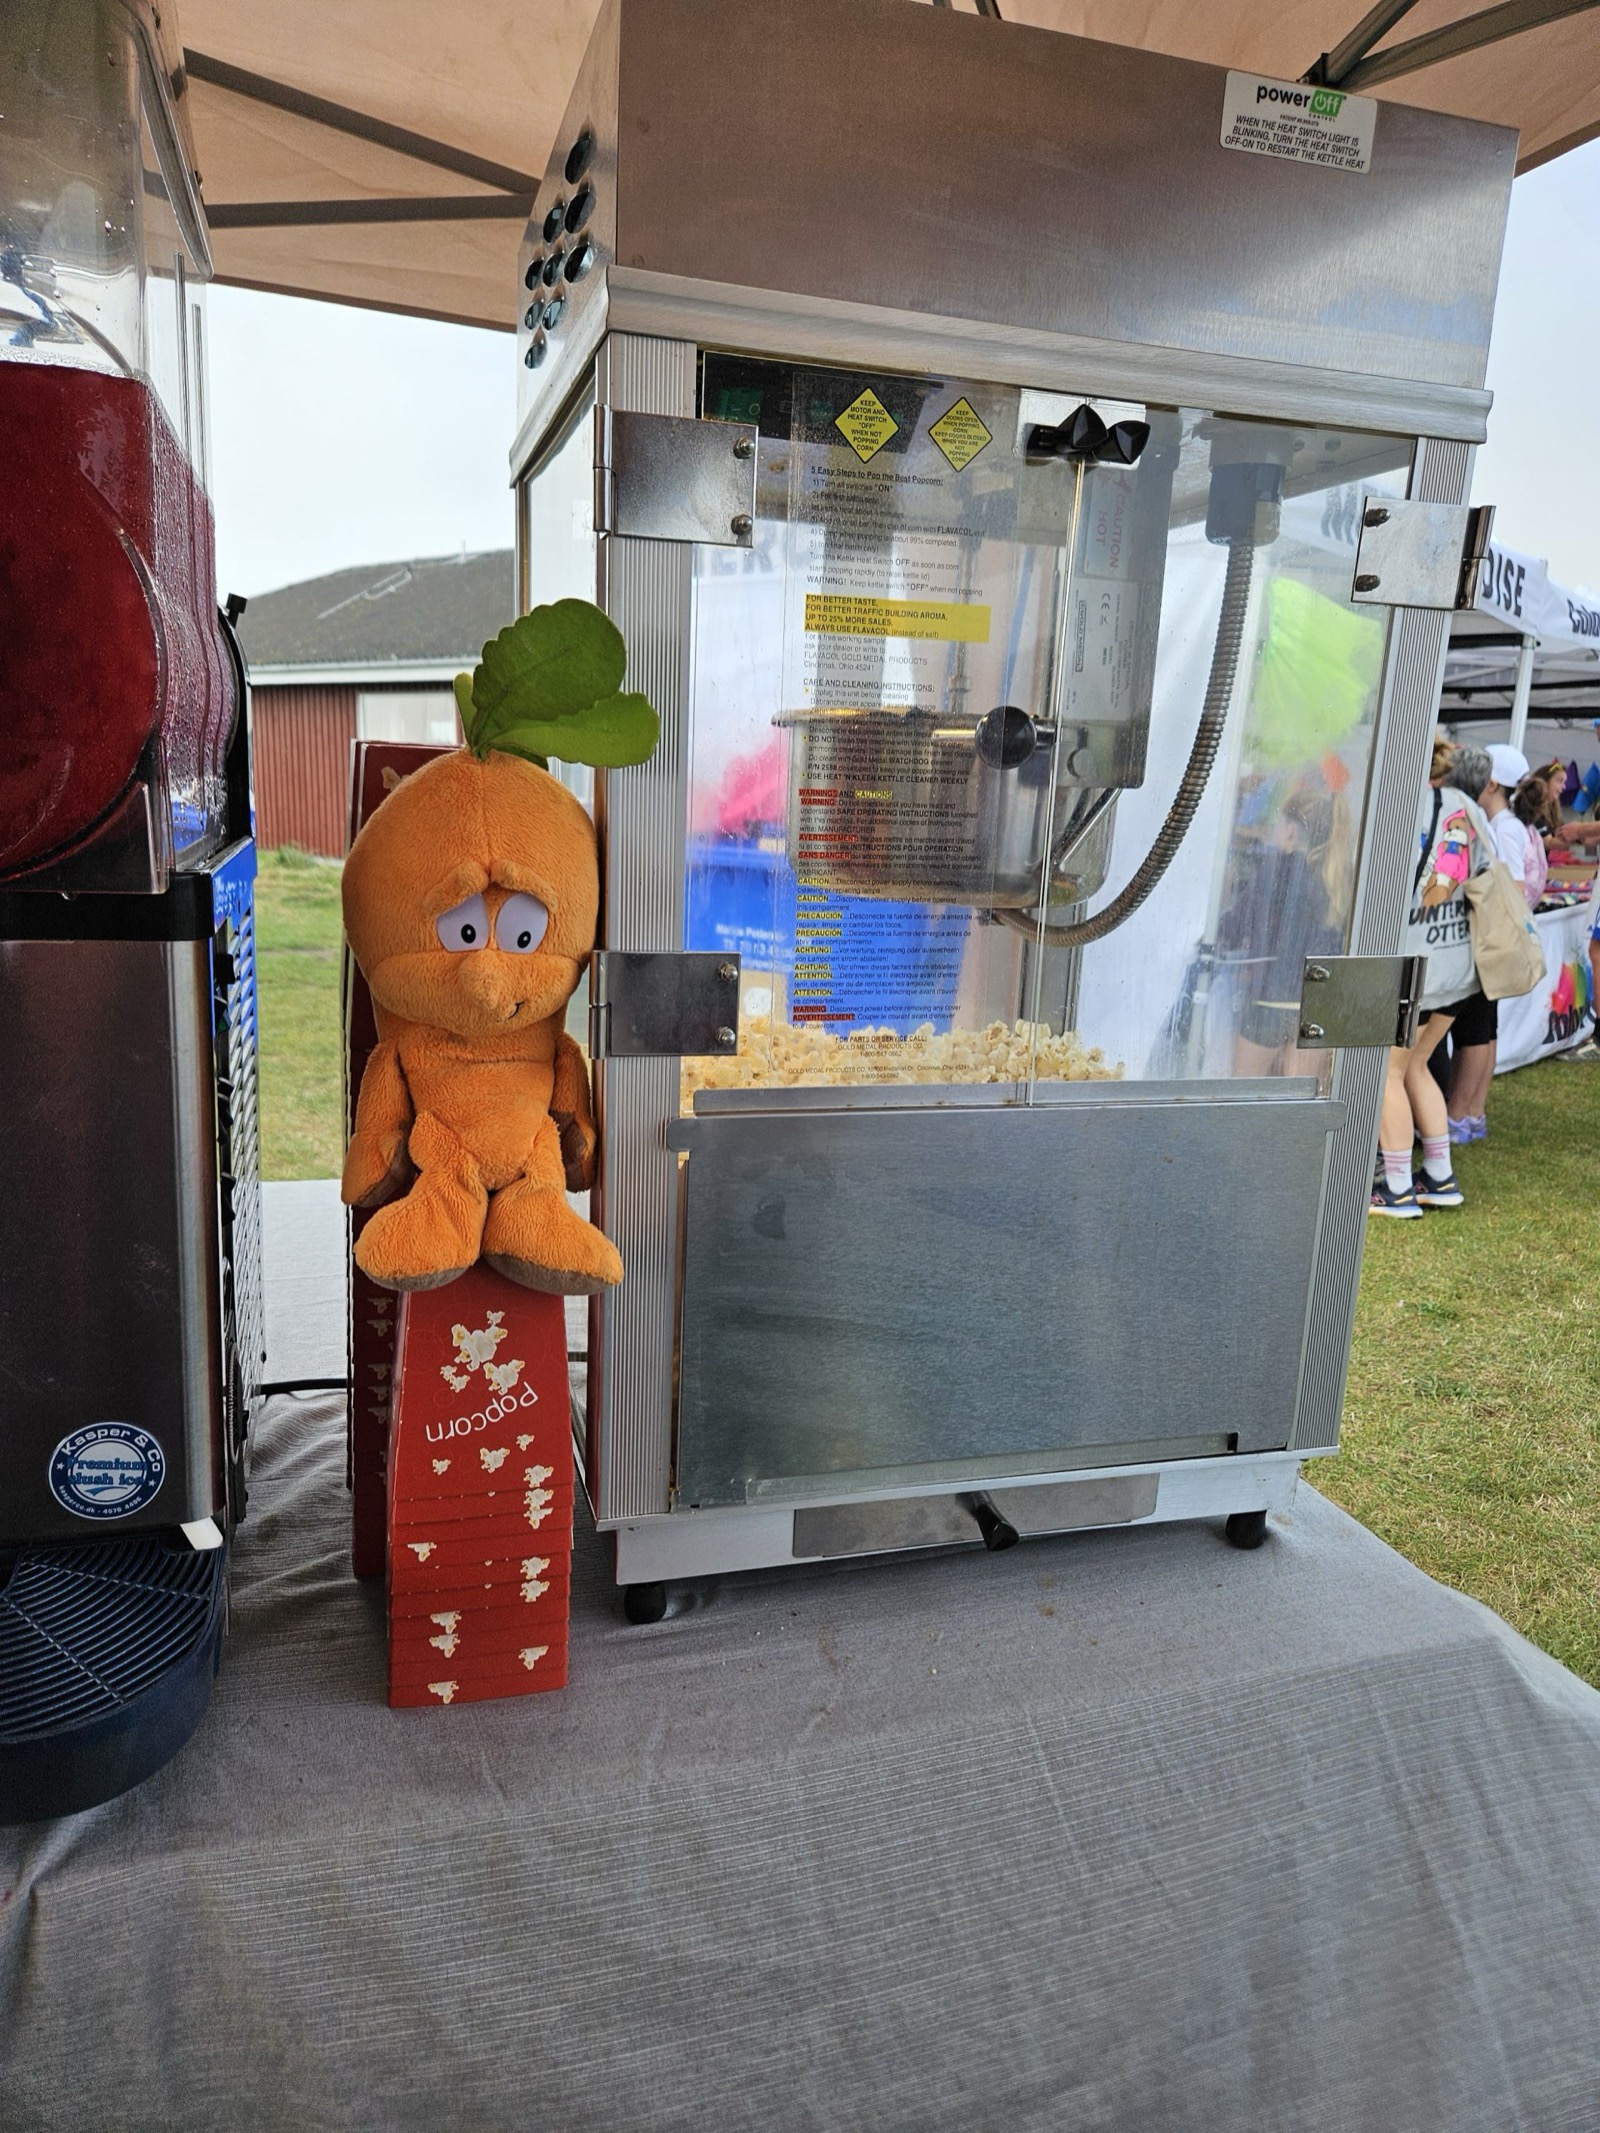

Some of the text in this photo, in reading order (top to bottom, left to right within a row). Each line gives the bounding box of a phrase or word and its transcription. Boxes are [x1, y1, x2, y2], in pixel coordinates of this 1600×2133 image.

[1257, 85, 1310, 108] power
[1309, 113, 1335, 122] CONTROL
[1236, 115, 1359, 146] WHEN THE HEAT SWITCH LIGHT IS
[1232, 126, 1359, 157] BLINKING, TURN THE HEAT SWITCH
[1225, 136, 1365, 169] OFF-ON TO RESTART THE KETTLE HEAT
[848, 413, 863, 421] HEAT
[818, 467, 834, 476] Easy
[837, 469, 856, 478] Steps
[867, 472, 880, 480] Pop
[937, 526, 972, 536] FLAVACOL
[1095, 511, 1109, 546] HOT
[1109, 494, 1127, 569] CAUTION
[895, 559, 910, 567] OFF
[807, 575, 847, 586] WARNING!
[807, 595, 852, 605] FOR BETTER
[823, 605, 851, 614] BETTER
[854, 608, 883, 616] TRAFFIC
[885, 609, 918, 618] BUILDING
[829, 615, 843, 623] 25%
[845, 616, 866, 625] MORE
[805, 623, 835, 632] ALWAYS
[837, 624, 851, 633] USE
[853, 626, 890, 635] FLAVACOL
[803, 678, 879, 689] CARE AND CLEANING
[889, 758, 929, 766] WATCHDOG
[807, 772, 822, 780] USE
[852, 774, 874, 782] KLEEN
[876, 775, 904, 783] KETTLE
[906, 776, 938, 784] CLEANER
[800, 789, 854, 798] WARNINGS AND
[857, 809, 897, 817] OPERATING
[899, 810, 949, 818] INSTRUCTIONS
[851, 844, 901, 852] INSTRUCTIONS
[425, 1381, 539, 1443] Popcorn
[61, 1428, 160, 1472] Kasper & Co
[67, 1457, 147, 1470] Premium
[68, 1472, 143, 1485] slush ice
